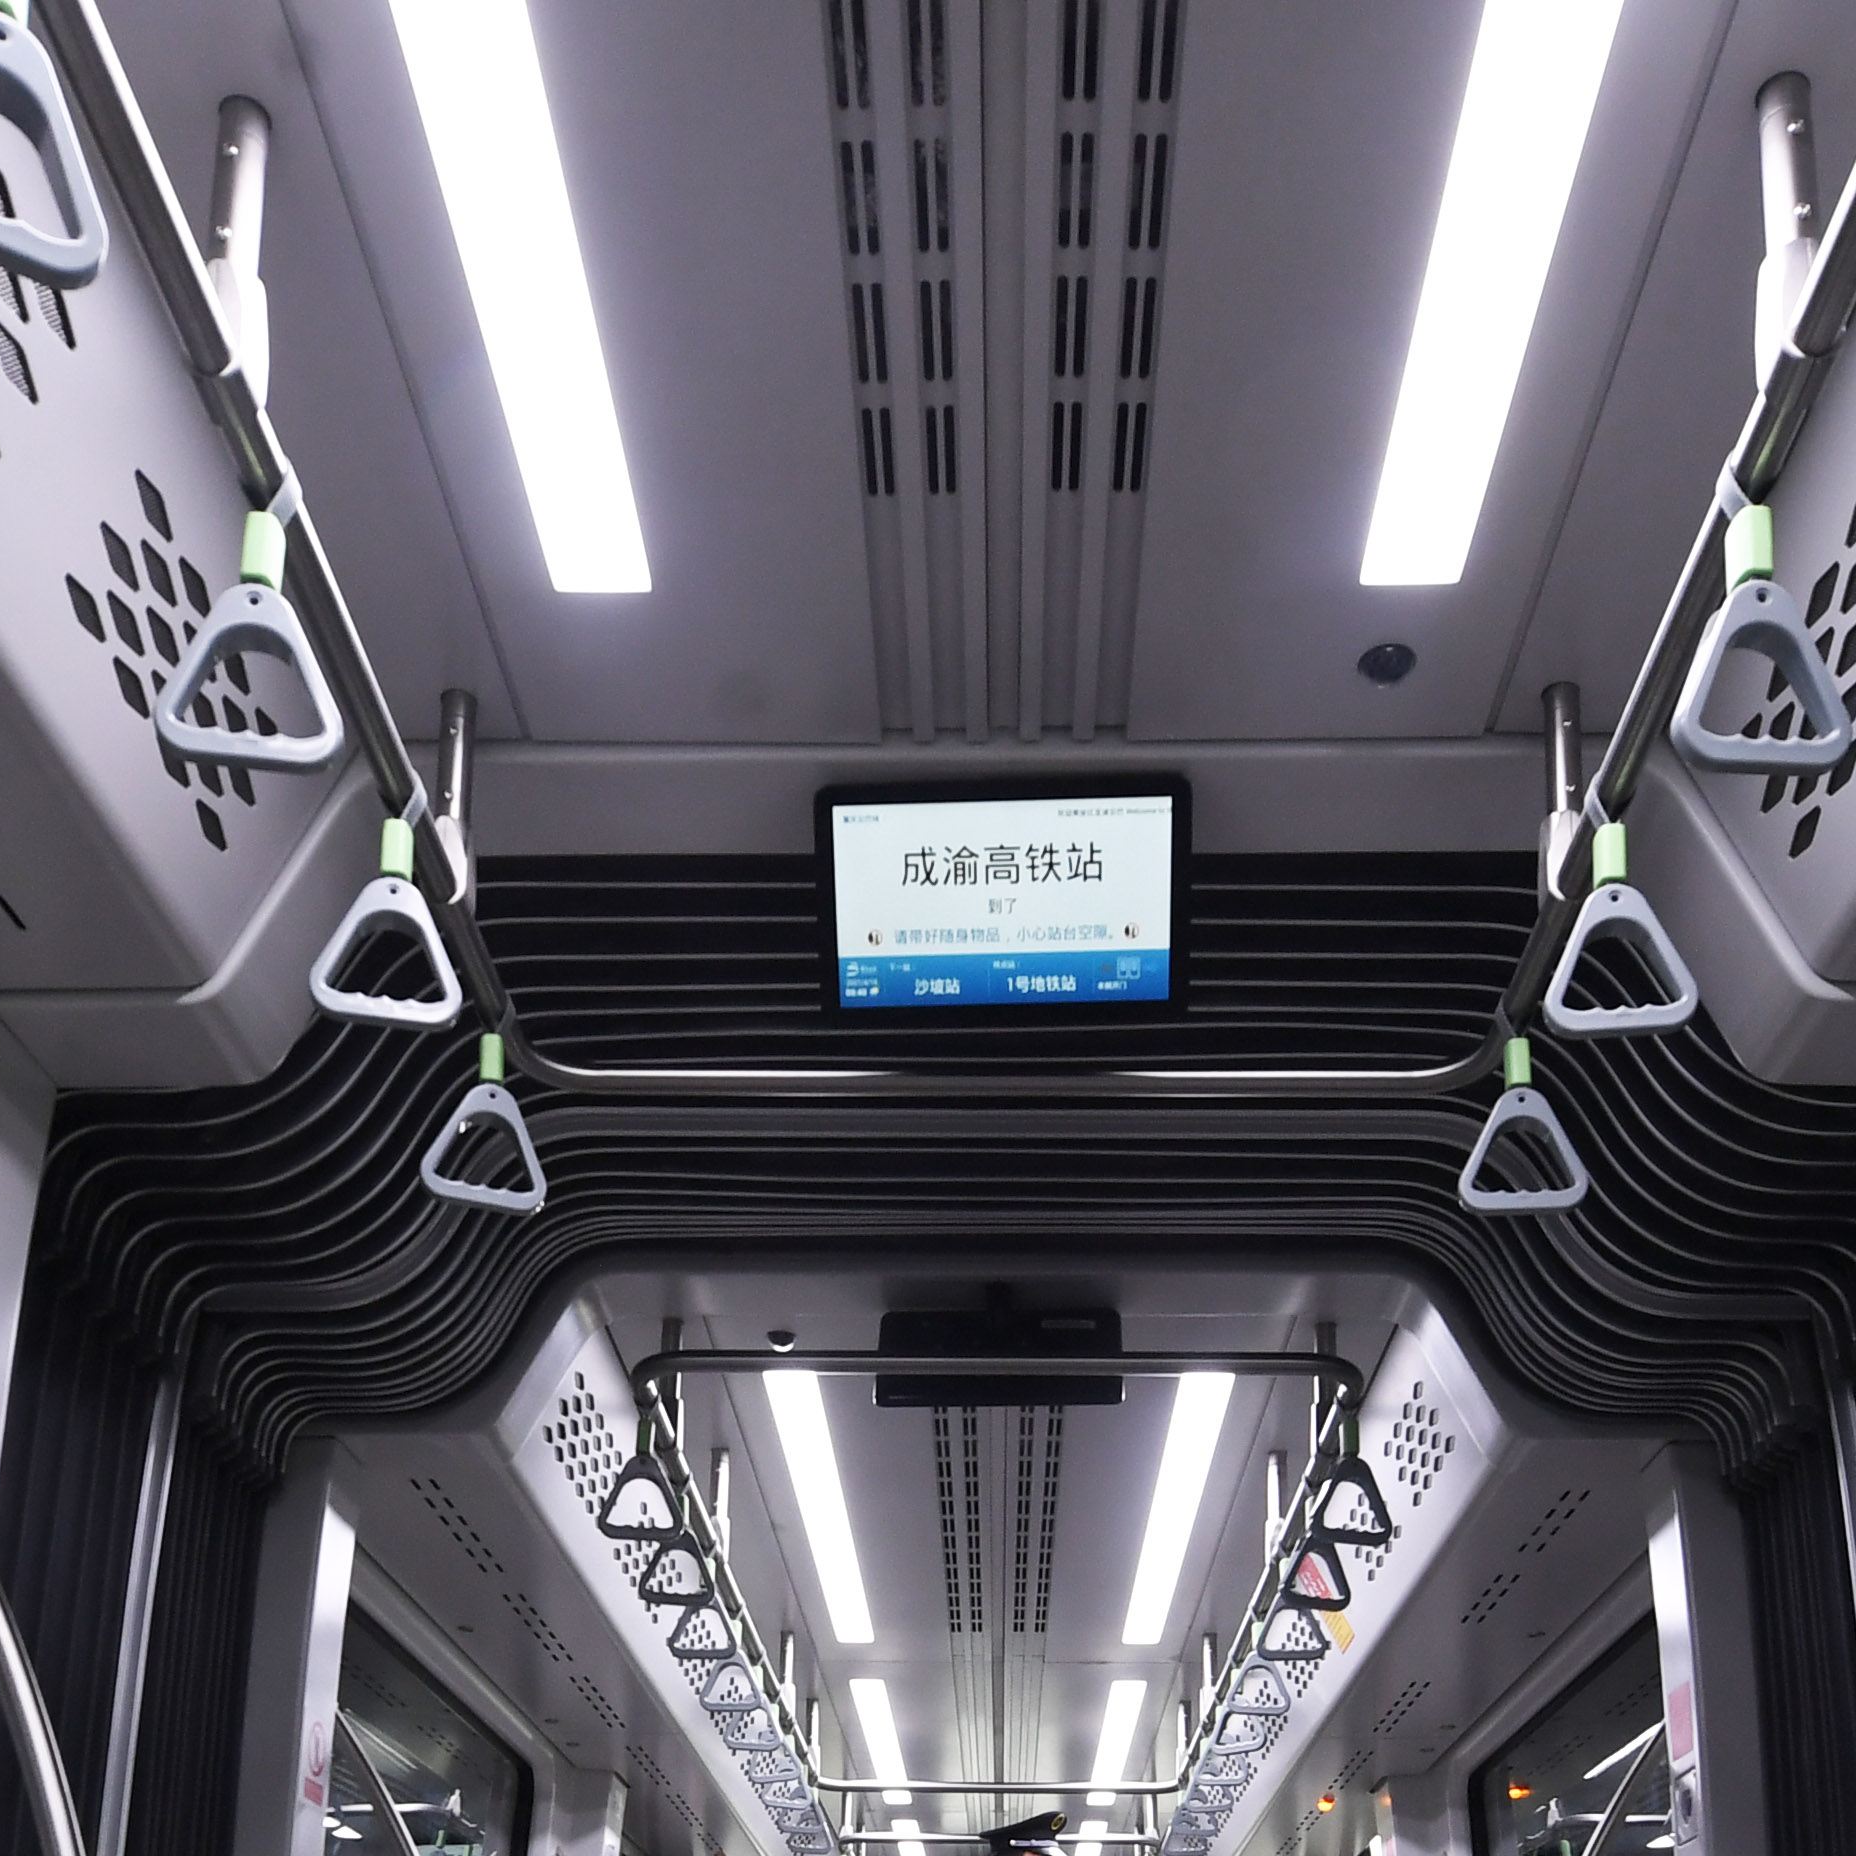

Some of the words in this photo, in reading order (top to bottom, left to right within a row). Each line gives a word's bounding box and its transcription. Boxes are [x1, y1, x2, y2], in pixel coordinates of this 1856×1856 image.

[902, 842, 1103, 886] 成渝高铁站
[988, 898, 1018, 915] 到了
[1007, 975, 1077, 993] 1号地铁站
